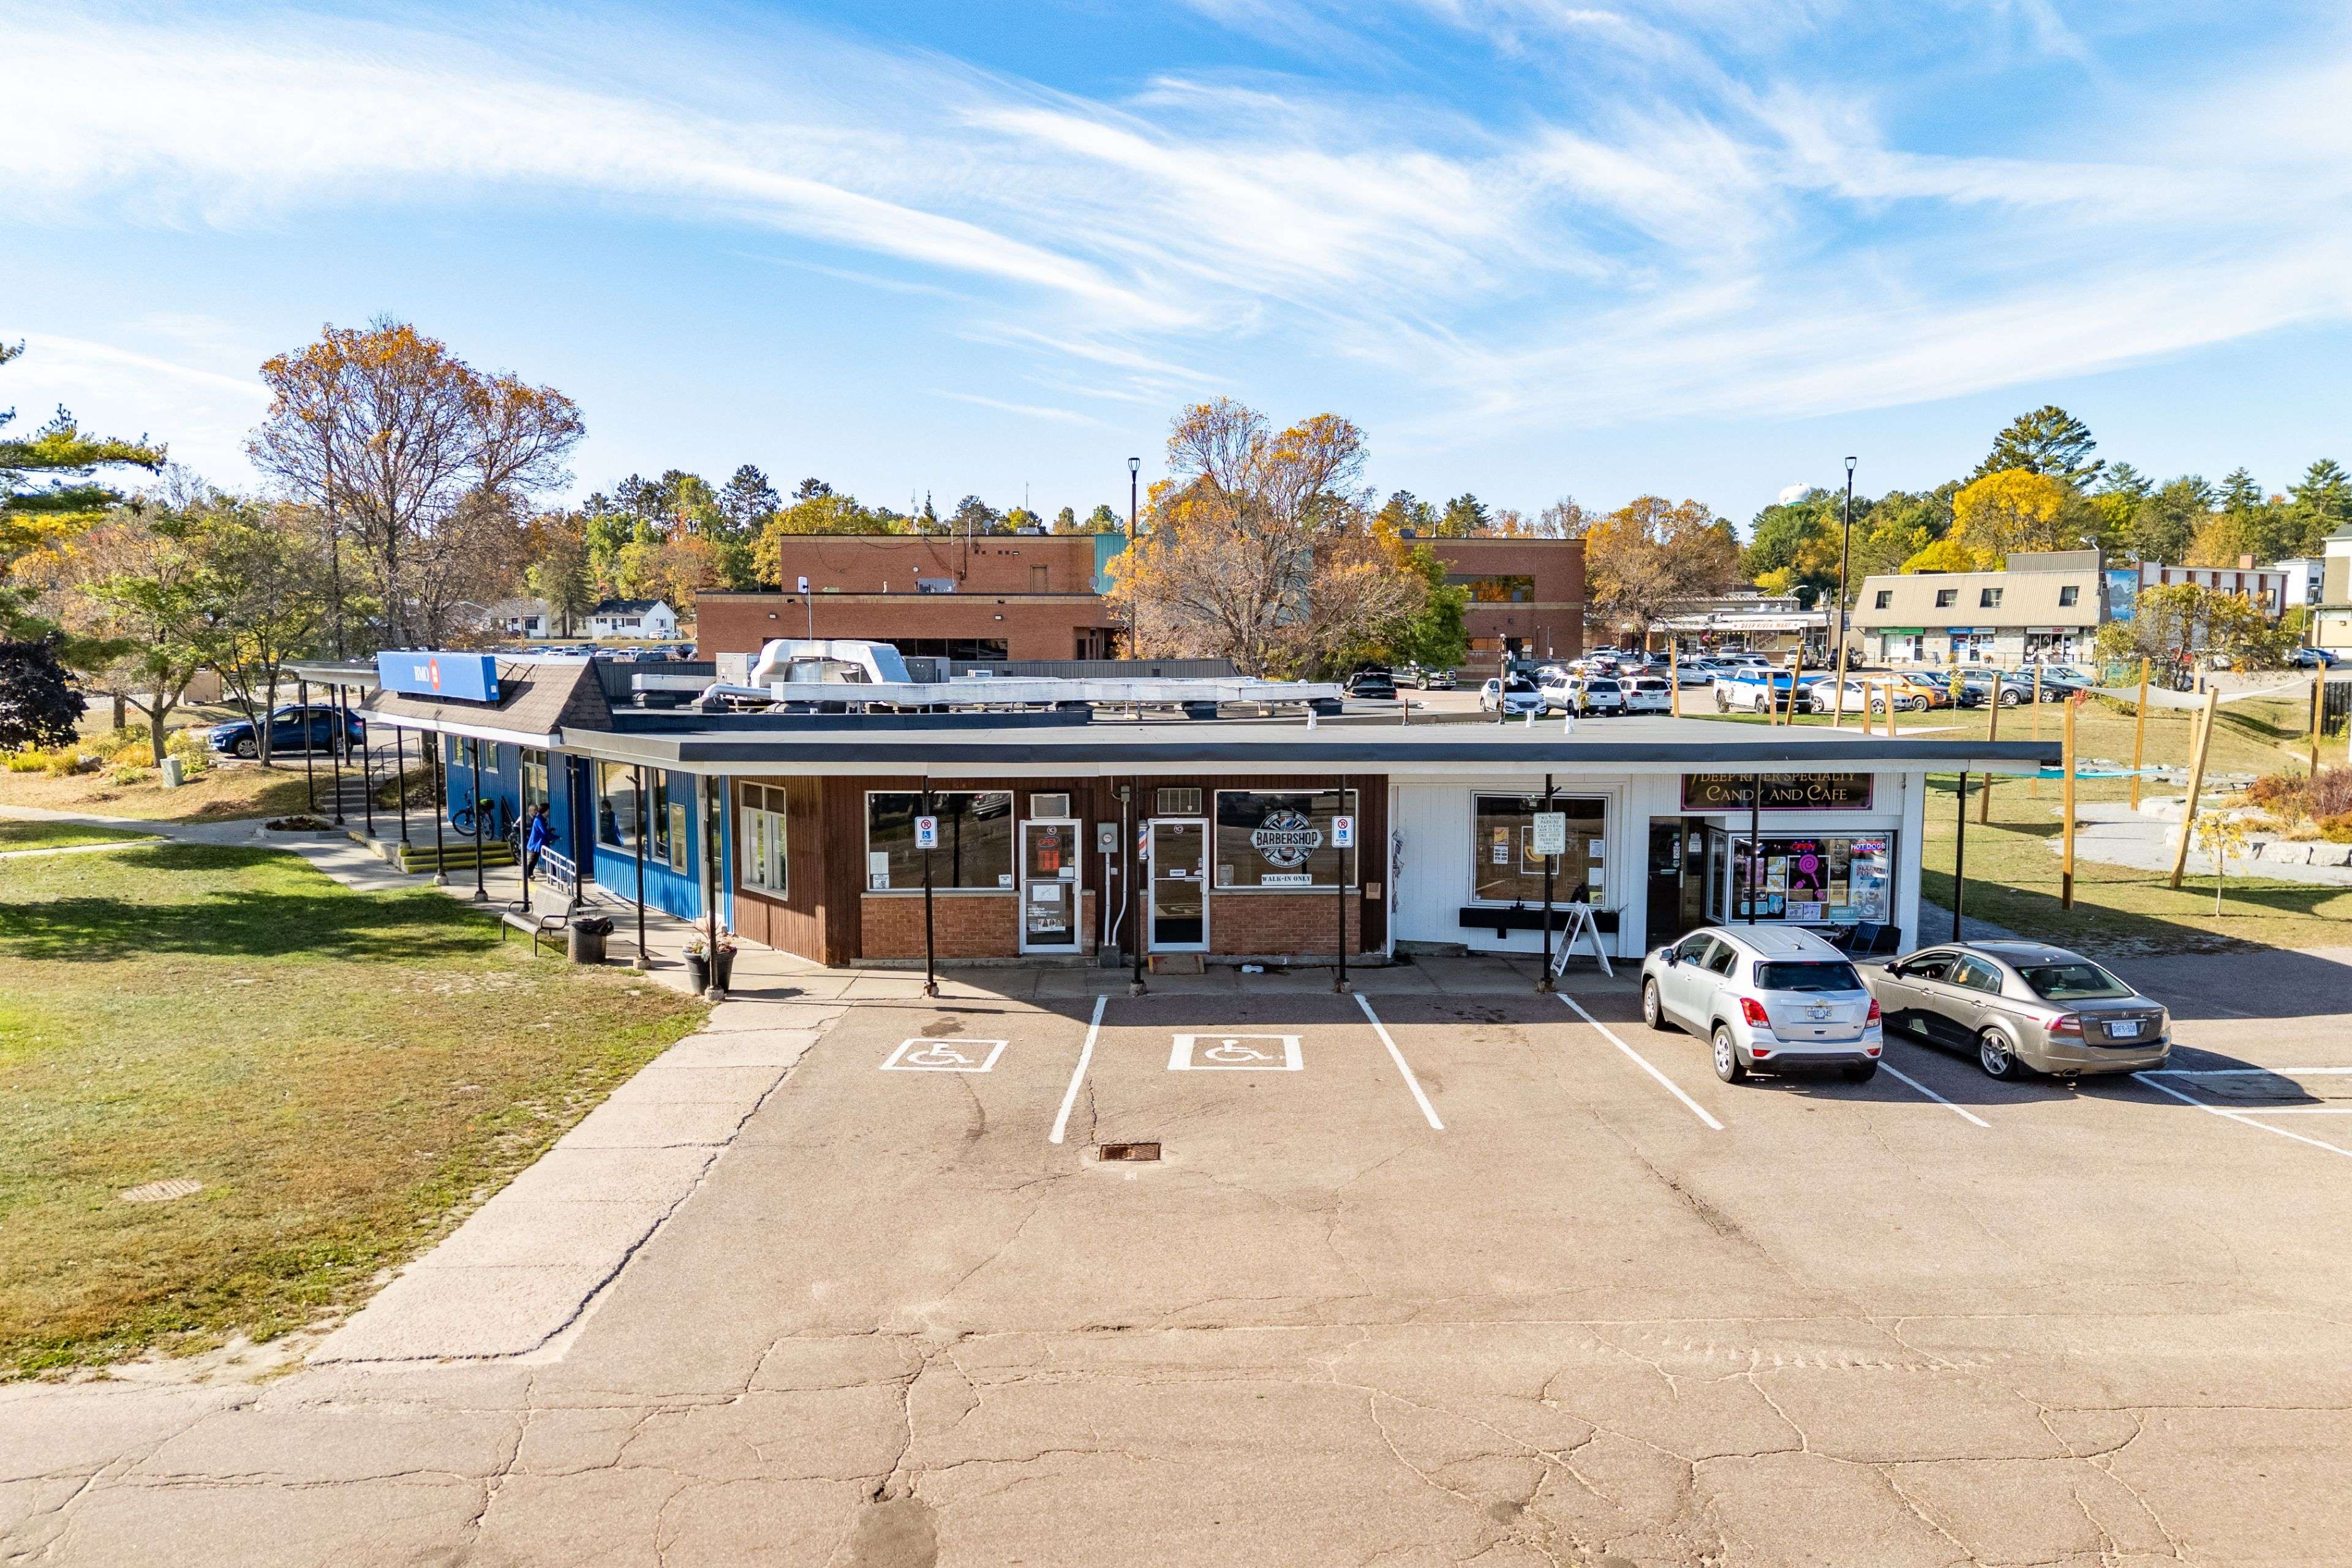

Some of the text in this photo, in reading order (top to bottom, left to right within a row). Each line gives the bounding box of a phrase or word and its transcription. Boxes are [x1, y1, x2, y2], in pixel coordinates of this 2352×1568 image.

[413, 666, 429, 682] BMO
[1770, 789, 1803, 800] AND
[1807, 785, 1847, 801] CAFE
[1256, 831, 1317, 846] BARBERSHOP
